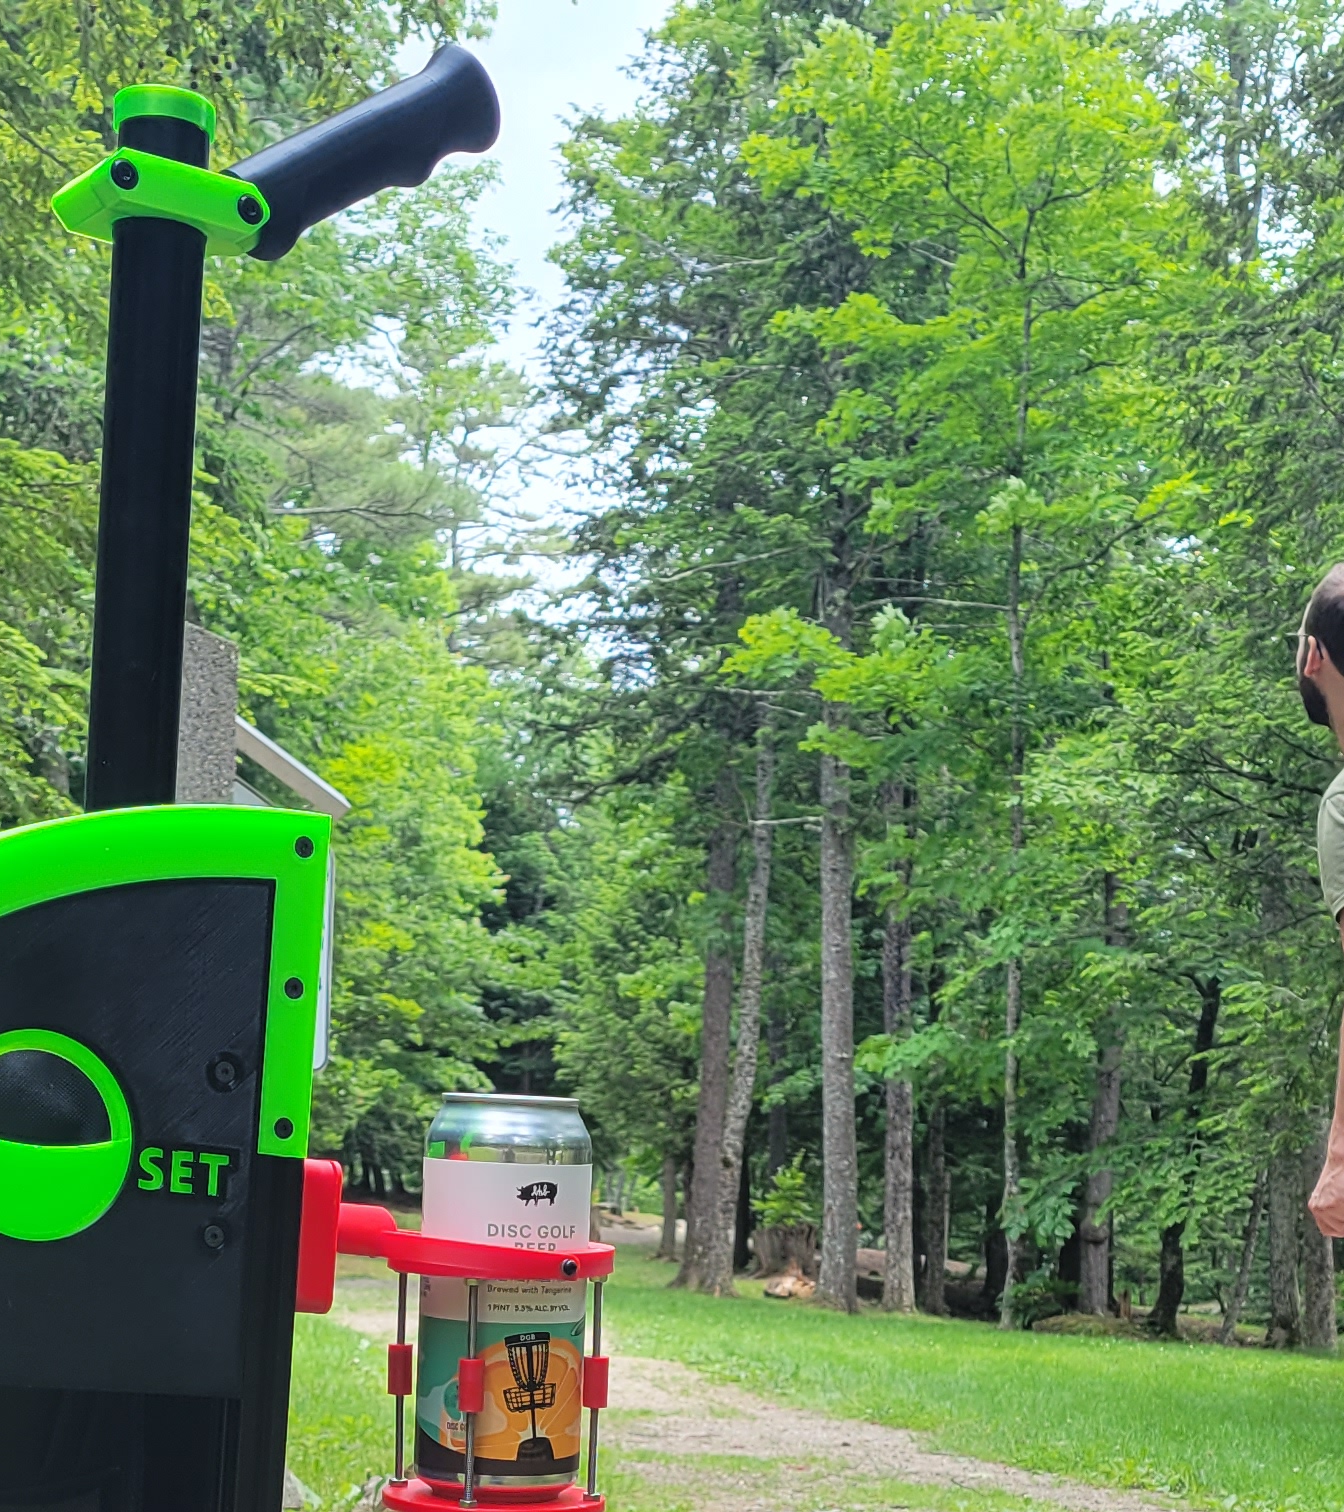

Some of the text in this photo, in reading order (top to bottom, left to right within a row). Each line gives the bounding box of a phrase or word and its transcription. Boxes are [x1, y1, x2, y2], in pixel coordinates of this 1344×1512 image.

[138, 1147, 230, 1196] SET
[487, 1223, 576, 1239] DISC GOLF
[487, 1284, 519, 1293] Brewed
[521, 1285, 539, 1294] with
[492, 1304, 511, 1312] PINT
